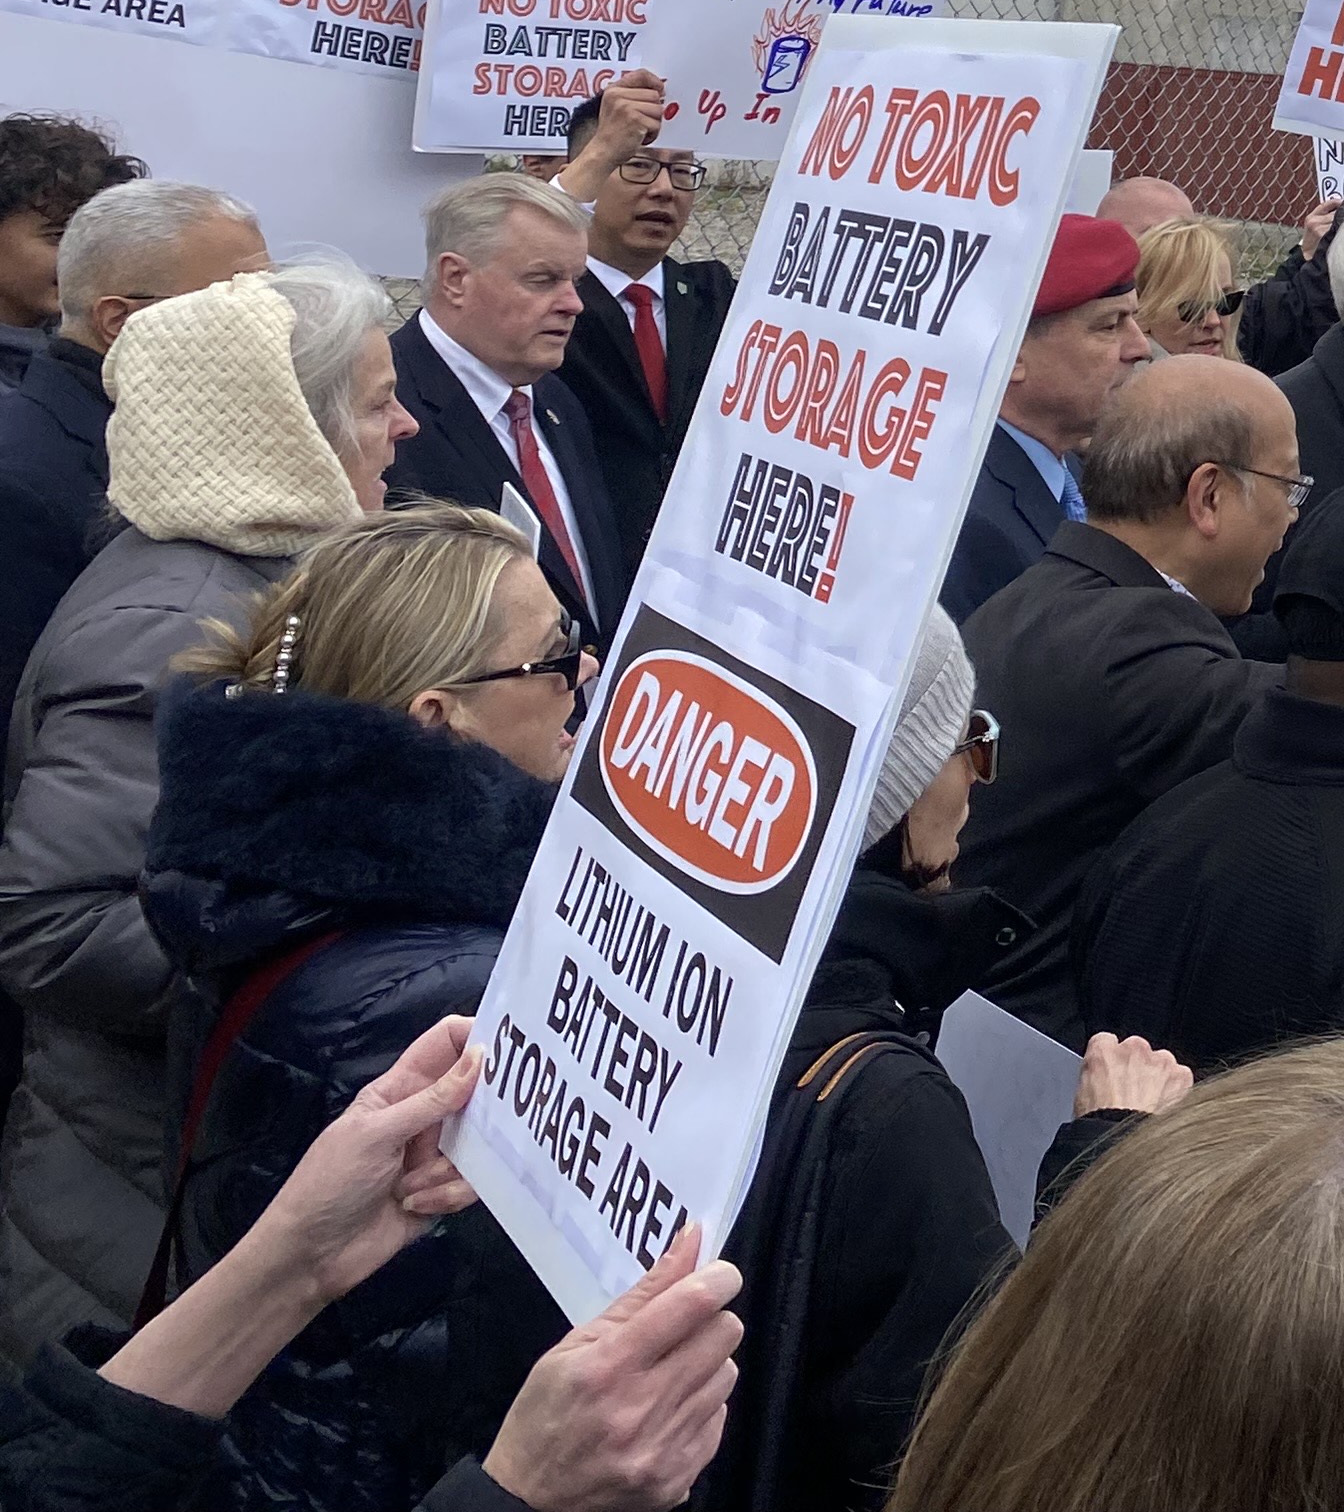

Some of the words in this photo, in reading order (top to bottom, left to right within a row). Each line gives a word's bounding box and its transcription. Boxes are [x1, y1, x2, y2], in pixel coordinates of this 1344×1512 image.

[311, 21, 422, 71] HERE!
[483, 23, 636, 61] BATTERY
[698, 89, 727, 135] Up
[744, 93, 781, 124] In
[503, 104, 570, 137] HER
[798, 85, 875, 179] NO
[867, 87, 1042, 207] TOXIC
[769, 201, 990, 336] BATTERY
[720, 319, 948, 480] STORAGE
[714, 453, 856, 604] HERE!
[610, 670, 795, 872] DANGER
[554, 846, 670, 987] LITHIUM
[664, 939, 733, 1057] ION
[483, 1012, 611, 1202] STORAGE
[546, 955, 682, 1134] BATTERY
